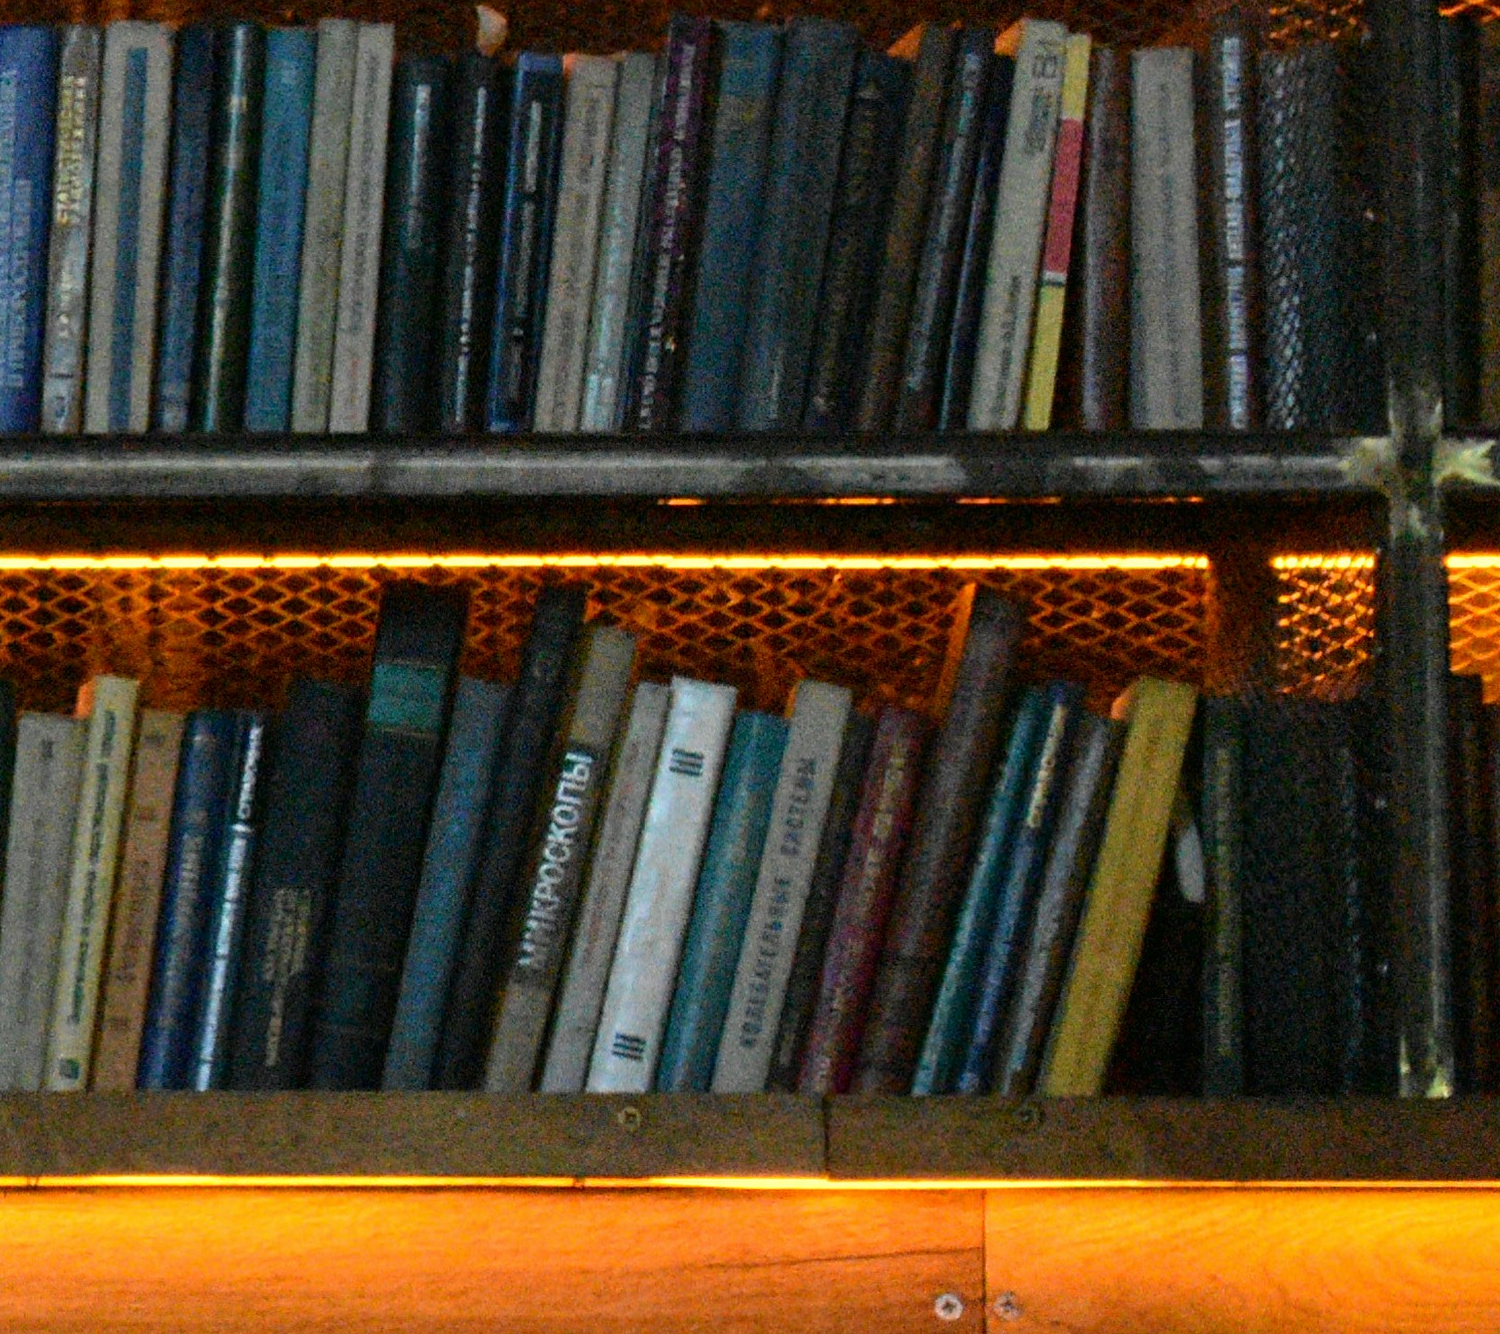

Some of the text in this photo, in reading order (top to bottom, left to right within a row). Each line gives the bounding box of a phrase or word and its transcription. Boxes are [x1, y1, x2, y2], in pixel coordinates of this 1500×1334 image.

[514, 750, 596, 971] МИКРОСКОПЫ
[738, 755, 818, 1050] КОЛЕБАТЕЛЬНЫЕ СИСТЕМЫ
